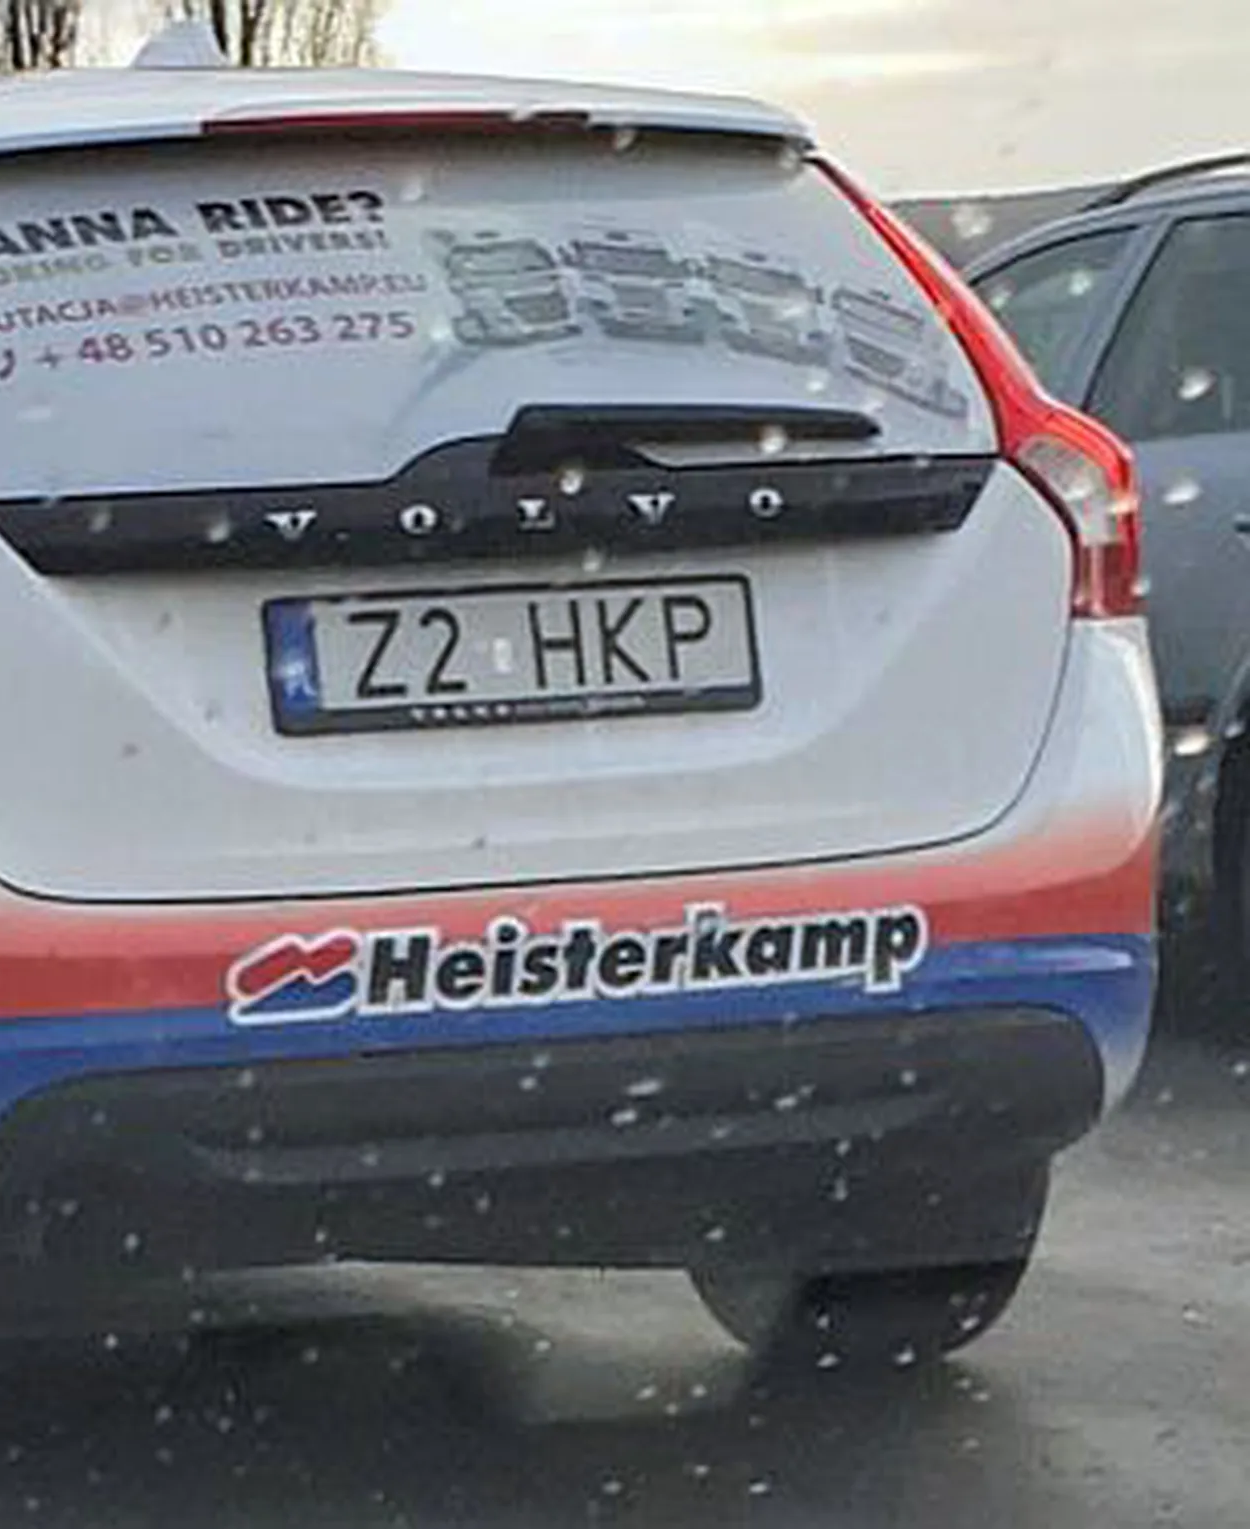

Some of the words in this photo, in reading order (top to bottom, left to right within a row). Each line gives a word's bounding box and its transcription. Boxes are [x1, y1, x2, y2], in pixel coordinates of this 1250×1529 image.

[196, 190, 385, 234] RIDE?
[125, 243, 202, 268] FOR
[218, 229, 390, 260] DRIVERS!
[76, 331, 135, 364] 48
[144, 325, 229, 359] 510
[235, 316, 322, 348] 263
[332, 311, 415, 342] 275
[264, 488, 783, 539] VOLVO
[345, 608, 468, 698] Z2
[528, 595, 712, 688] HKP
[361, 910, 922, 1004] Heisterkamp
